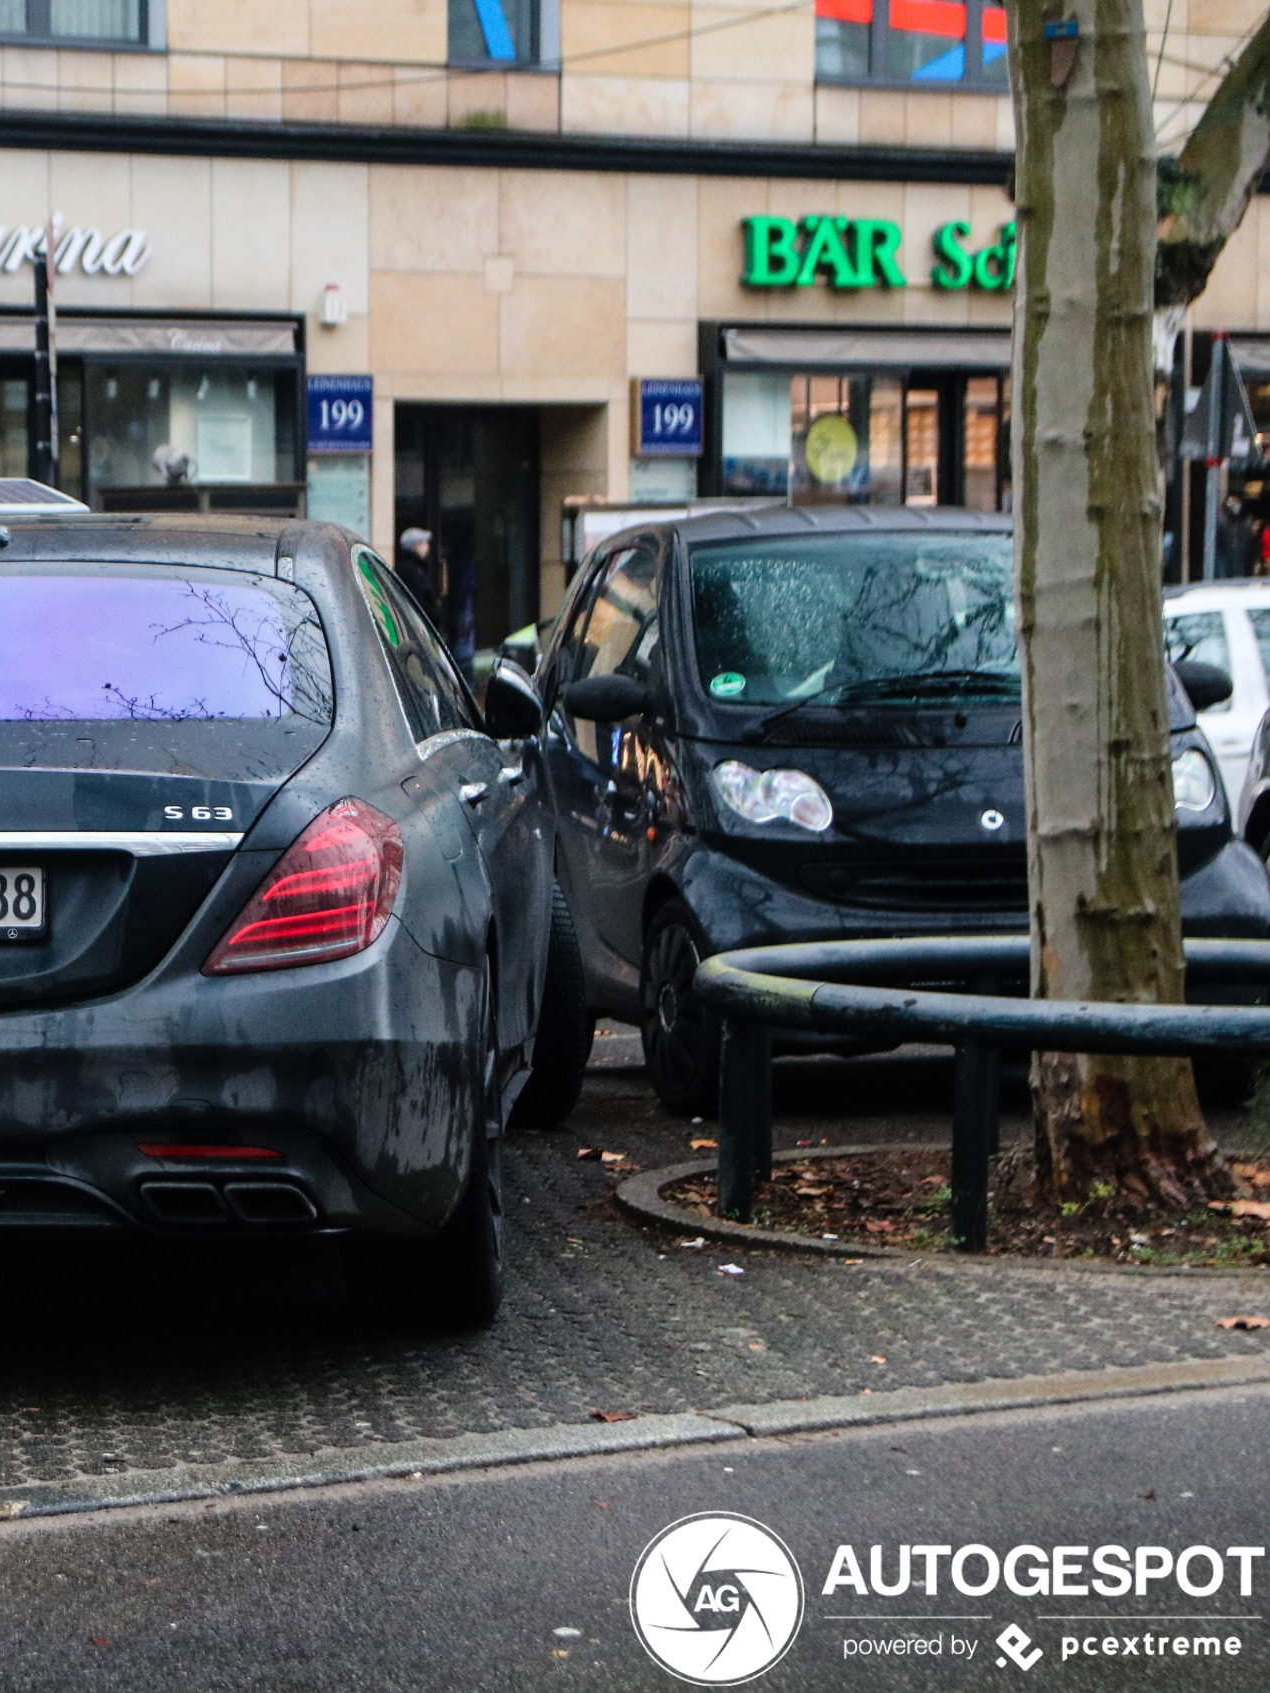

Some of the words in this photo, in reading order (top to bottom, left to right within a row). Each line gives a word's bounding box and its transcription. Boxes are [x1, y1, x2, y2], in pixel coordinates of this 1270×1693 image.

[742, 214, 907, 288] BÄR
[320, 399, 365, 431] 199
[654, 402, 694, 434] 199
[164, 805, 183, 820] S
[191, 806, 233, 820] 63
